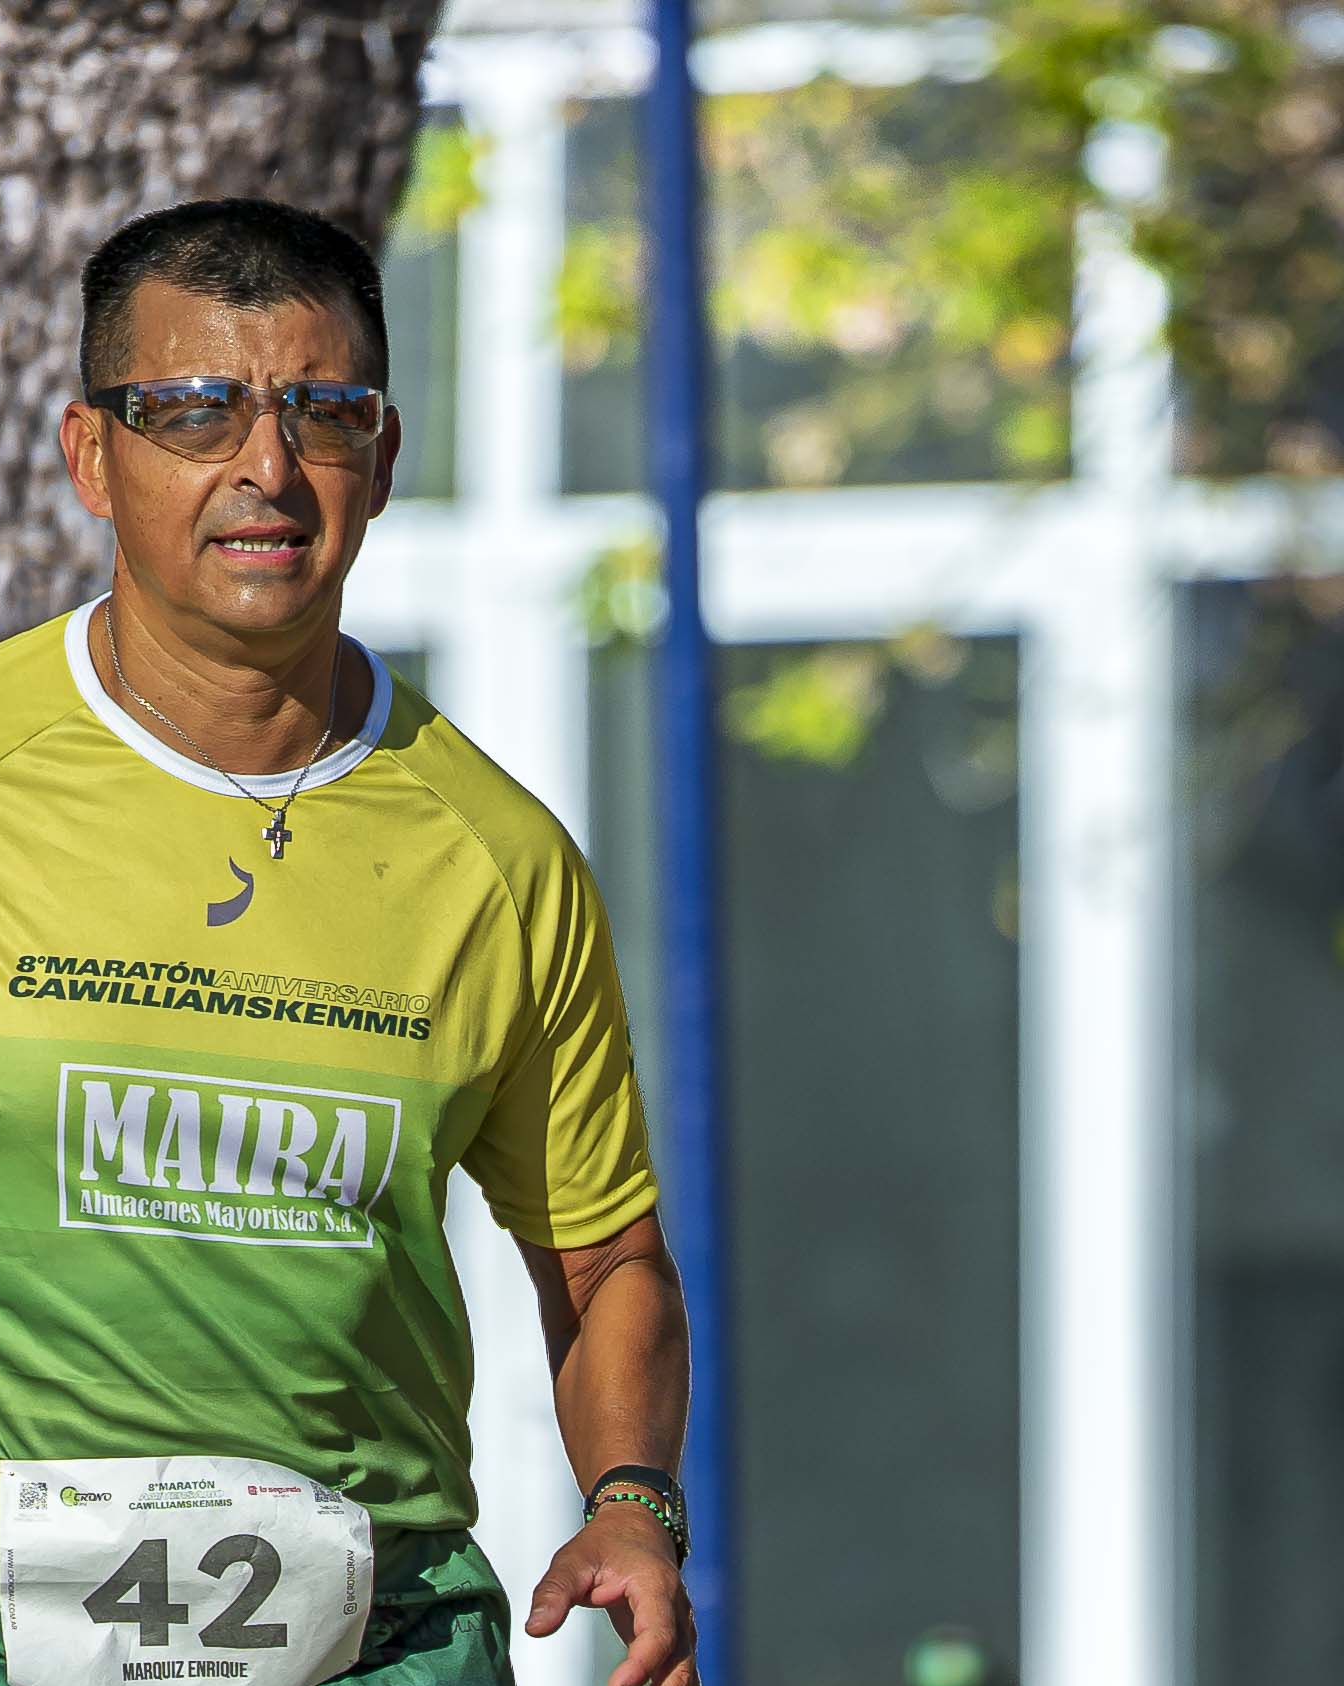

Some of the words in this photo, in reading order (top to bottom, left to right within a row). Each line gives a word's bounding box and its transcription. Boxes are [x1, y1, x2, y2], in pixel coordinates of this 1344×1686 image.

[8, 975, 432, 1042] CAWILLIAMSKEMMIS
[80, 1080, 368, 1207] MAIRA
[80, 1188, 202, 1226] Almacenes
[206, 1199, 319, 1234] Mayoristas
[128, 1498, 233, 1511] CAWILLIAMSKEMMIS
[82, 1534, 288, 1649] 42
[122, 1660, 185, 1682] MARQUIZ
[188, 1660, 249, 1680] ENRIQUE
